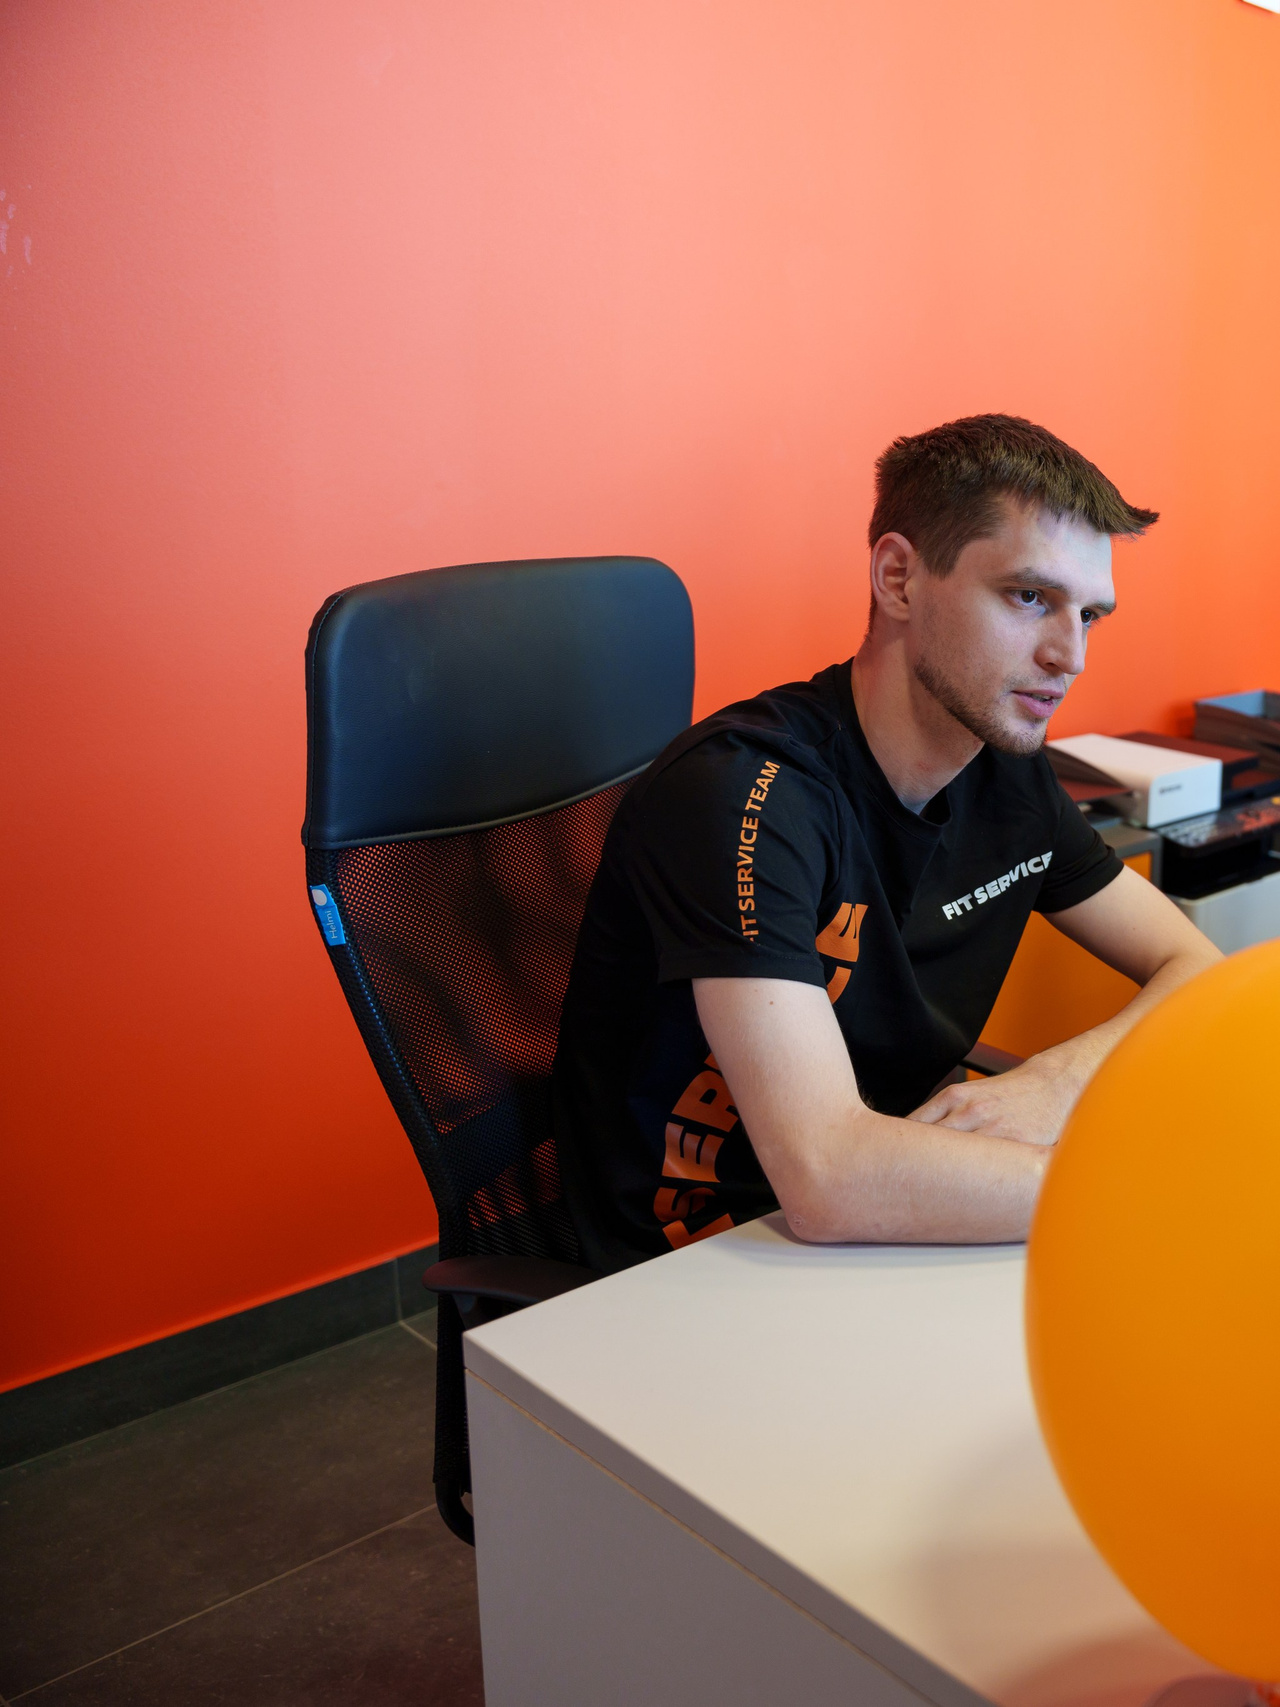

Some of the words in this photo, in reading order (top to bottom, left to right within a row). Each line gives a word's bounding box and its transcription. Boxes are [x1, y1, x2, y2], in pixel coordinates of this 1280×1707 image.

[744, 760, 781, 812] TEAM
[737, 816, 759, 912] SERVICE
[941, 893, 973, 921] FIT
[740, 914, 759, 943] IT
